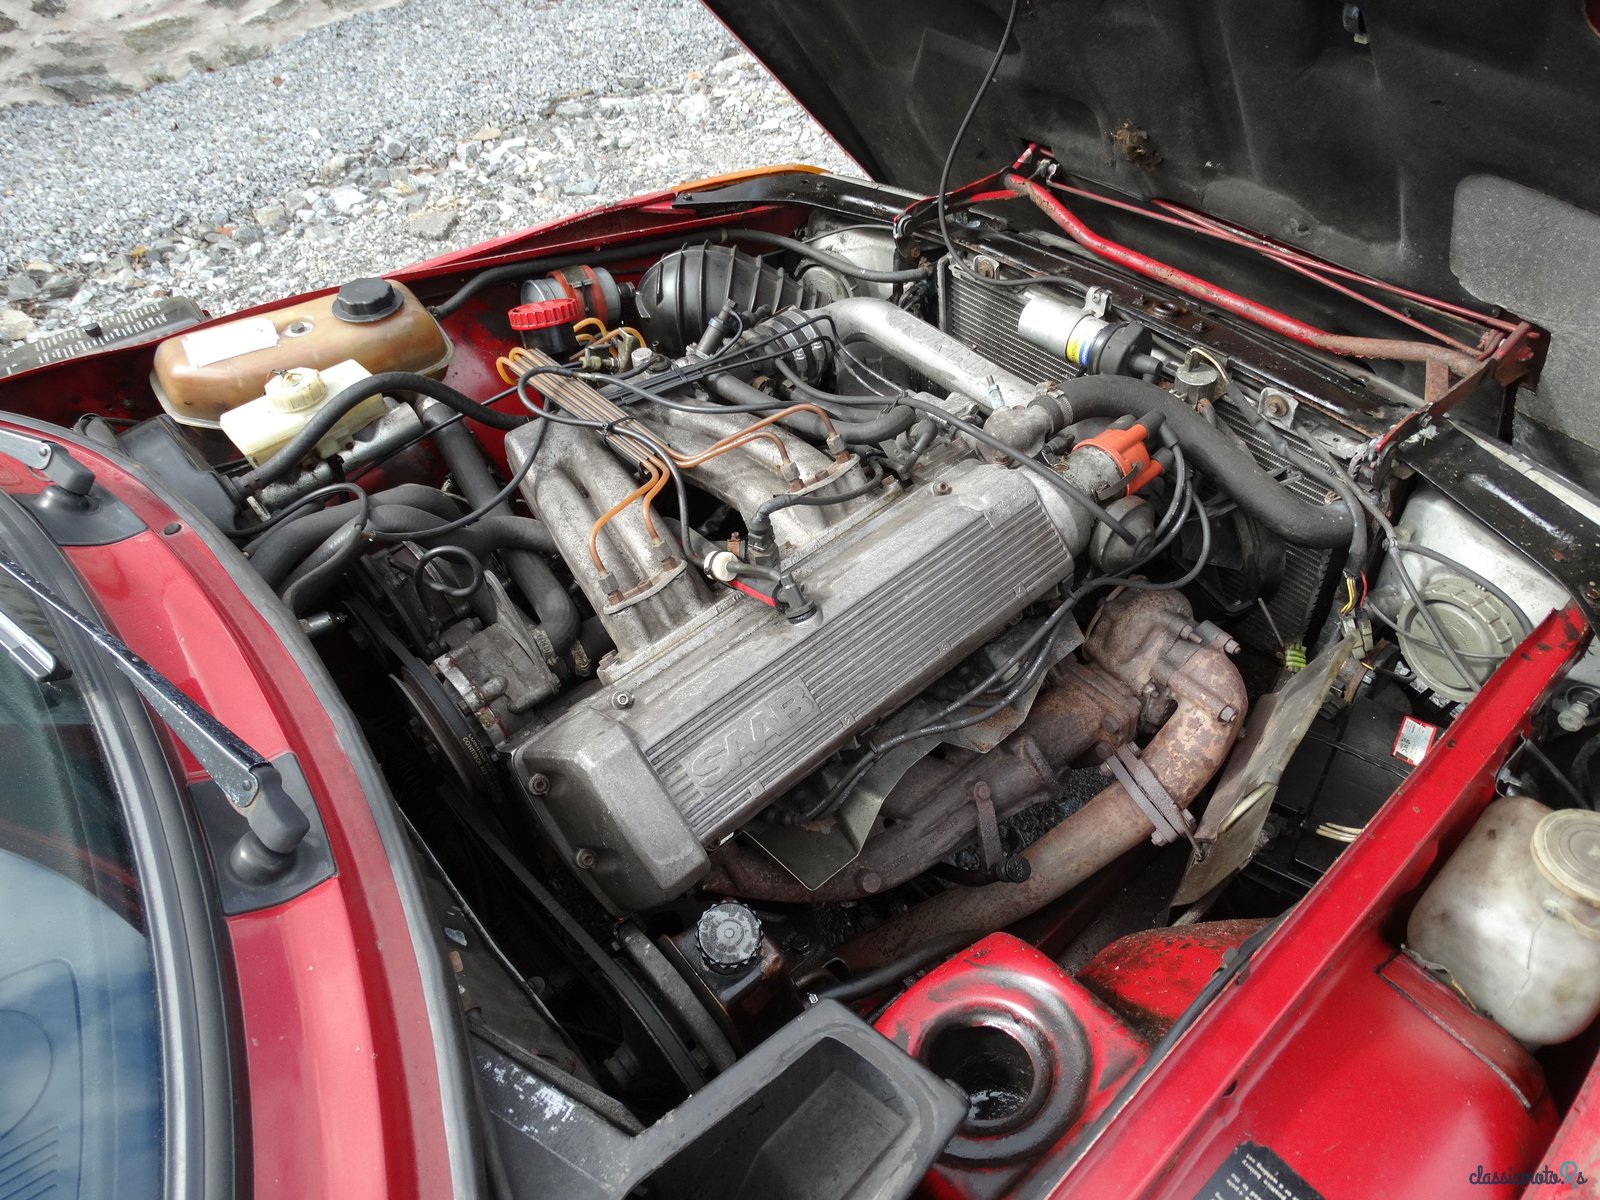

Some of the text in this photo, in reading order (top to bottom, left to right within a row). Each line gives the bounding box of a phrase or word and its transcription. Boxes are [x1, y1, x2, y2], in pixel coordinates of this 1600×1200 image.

[692, 685, 815, 789] SAAB
[1241, 1159, 1262, 1181] battery
[1256, 1161, 1279, 1185] welding
